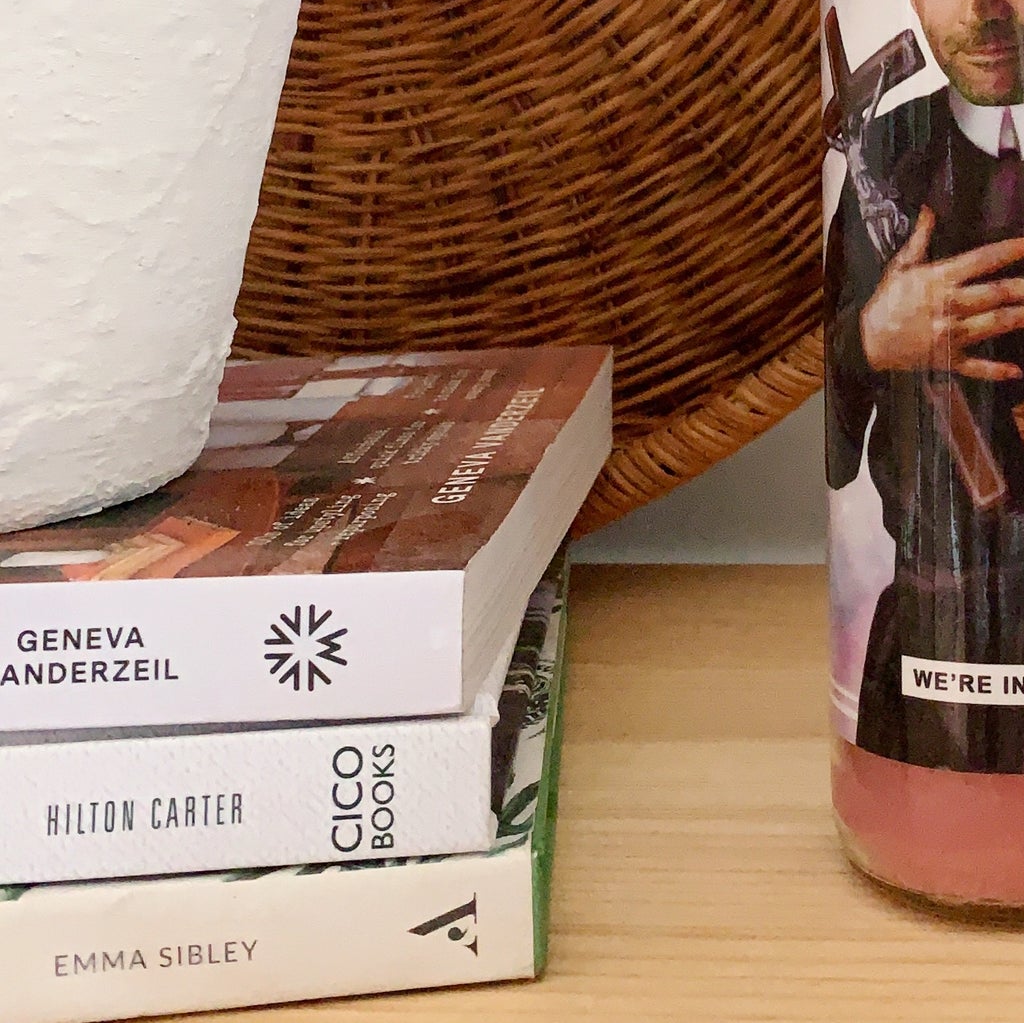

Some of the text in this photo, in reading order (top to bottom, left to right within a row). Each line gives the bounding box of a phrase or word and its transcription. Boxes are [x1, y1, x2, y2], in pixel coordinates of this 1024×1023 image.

[431, 450, 497, 505] GENEVA
[472, 387, 545, 450] VANDERZEIL
[16, 626, 145, 653] GENEVA
[0, 658, 179, 686] ANDERZEIL
[913, 668, 992, 694] WE'RE
[47, 792, 244, 836] HILTON CARTER
[331, 745, 364, 853] CICO
[371, 743, 396, 850] BOOKS
[54, 939, 259, 977] EMMA SIBLEY
